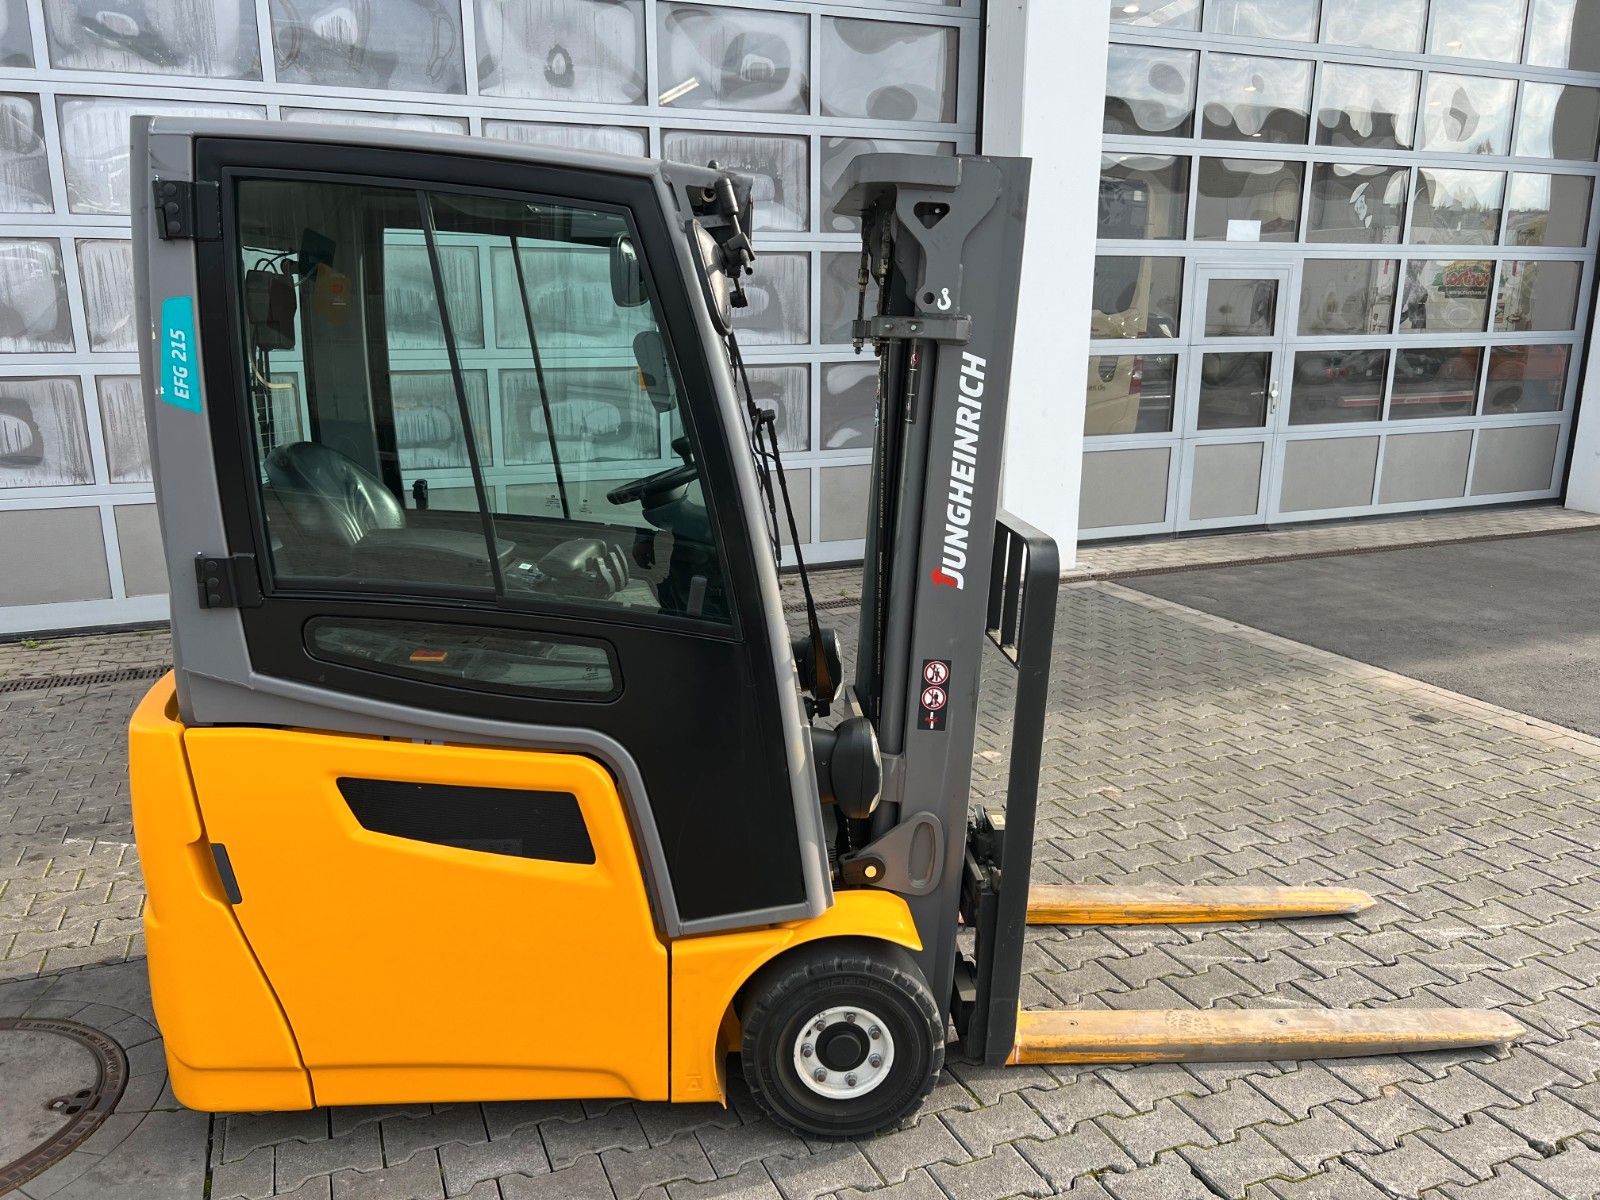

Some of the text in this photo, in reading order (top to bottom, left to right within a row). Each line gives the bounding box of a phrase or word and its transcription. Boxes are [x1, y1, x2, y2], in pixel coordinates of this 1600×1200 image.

[169, 328, 190, 399] EFG 215
[933, 351, 987, 590] JUNGHEINRICH
